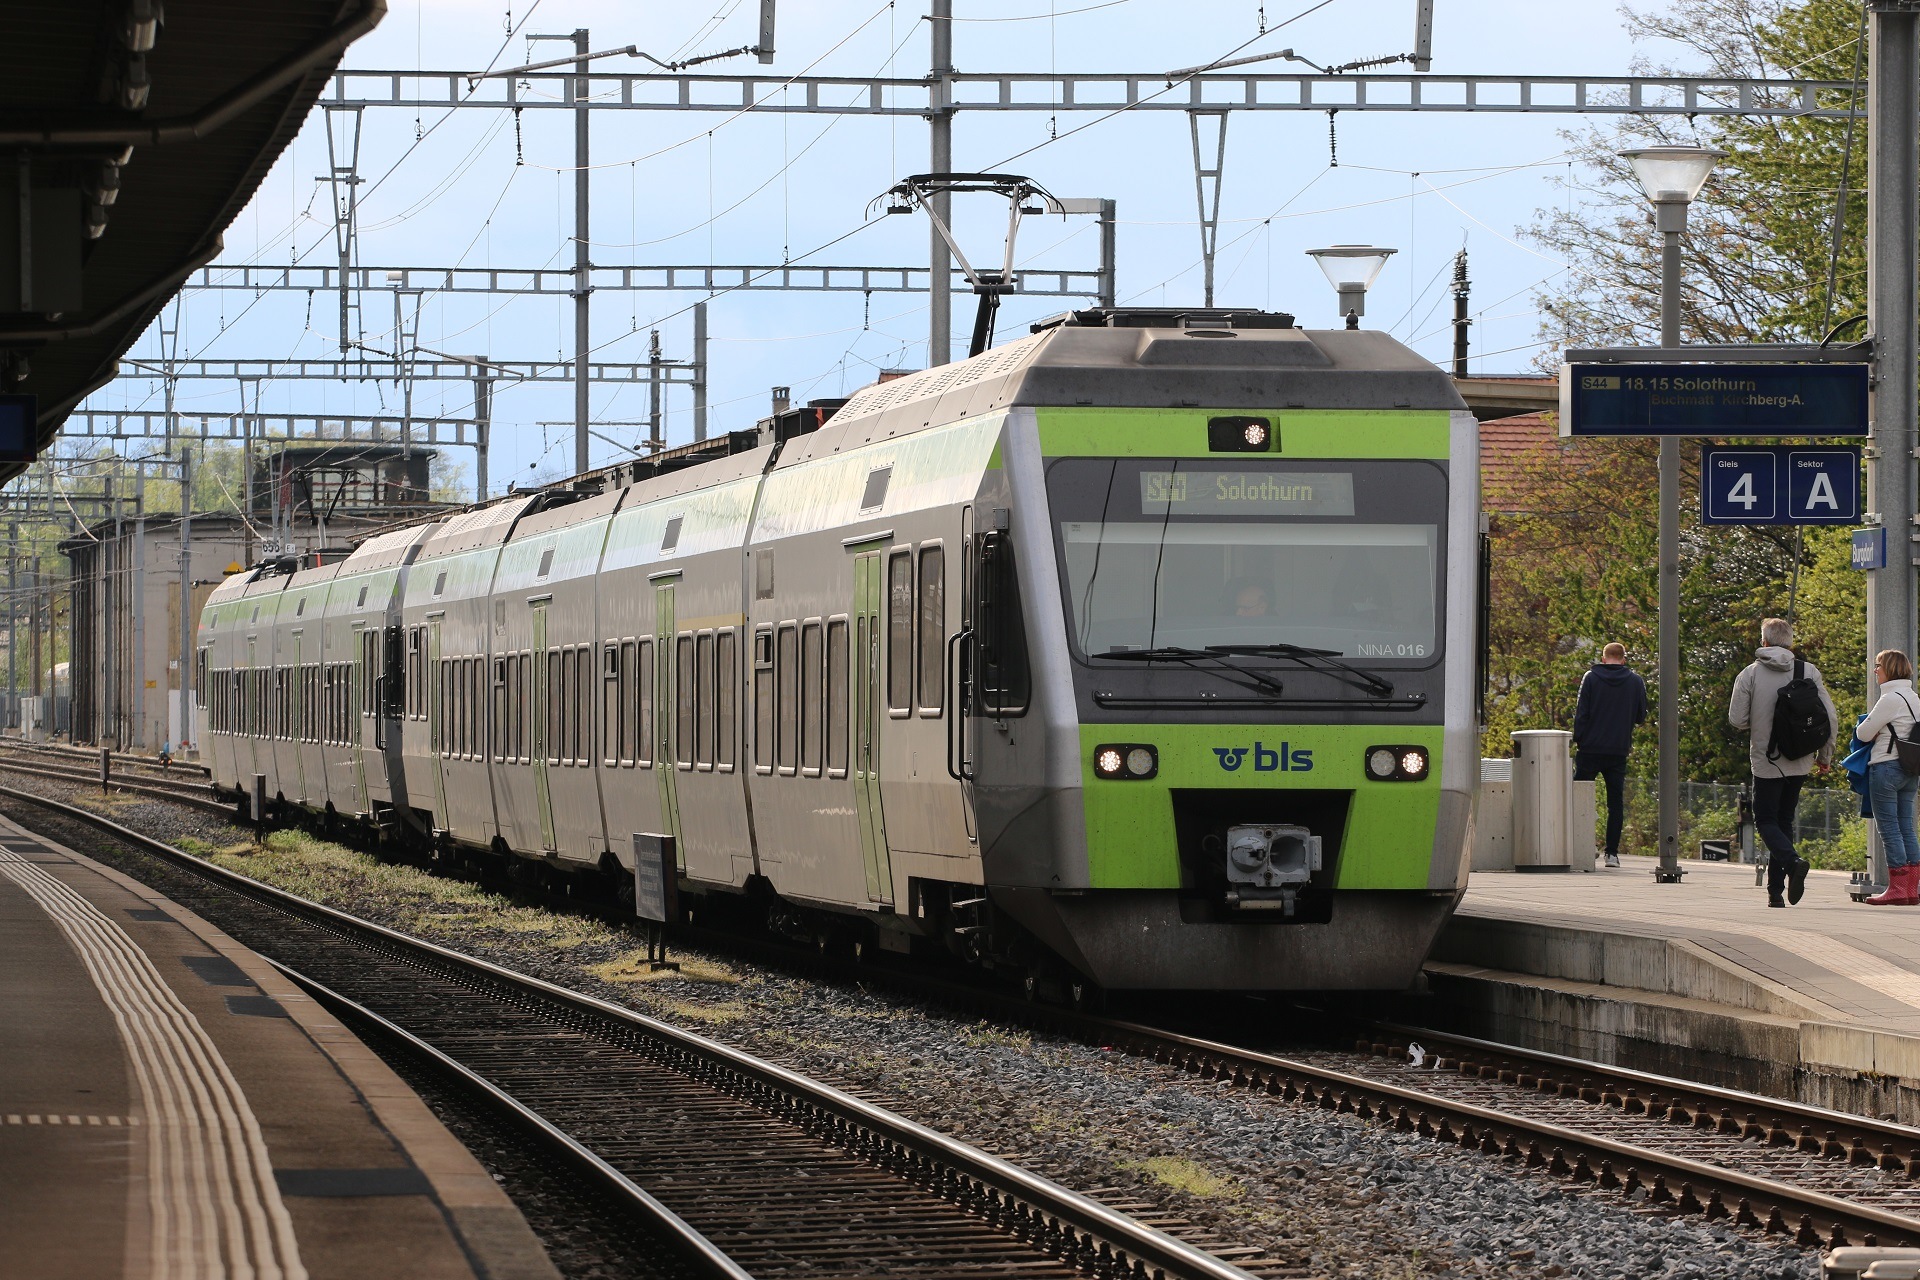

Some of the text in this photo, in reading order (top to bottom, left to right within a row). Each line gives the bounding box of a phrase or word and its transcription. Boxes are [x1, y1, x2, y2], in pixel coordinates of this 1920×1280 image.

[1583, 377, 1756, 391] S44 18.15 Solothurn
[1651, 394, 1805, 408] Buchmatt Kirchberg-A.
[1718, 460, 1738, 468] Gleis
[1797, 460, 1824, 468] Sektor
[1216, 474, 1313, 501] Solothurn
[1727, 472, 1757, 510] 4
[1805, 472, 1839, 510] A
[1852, 541, 1874, 567] Burgdorf
[1358, 644, 1425, 656] NINA 016
[1254, 741, 1314, 772] bls
